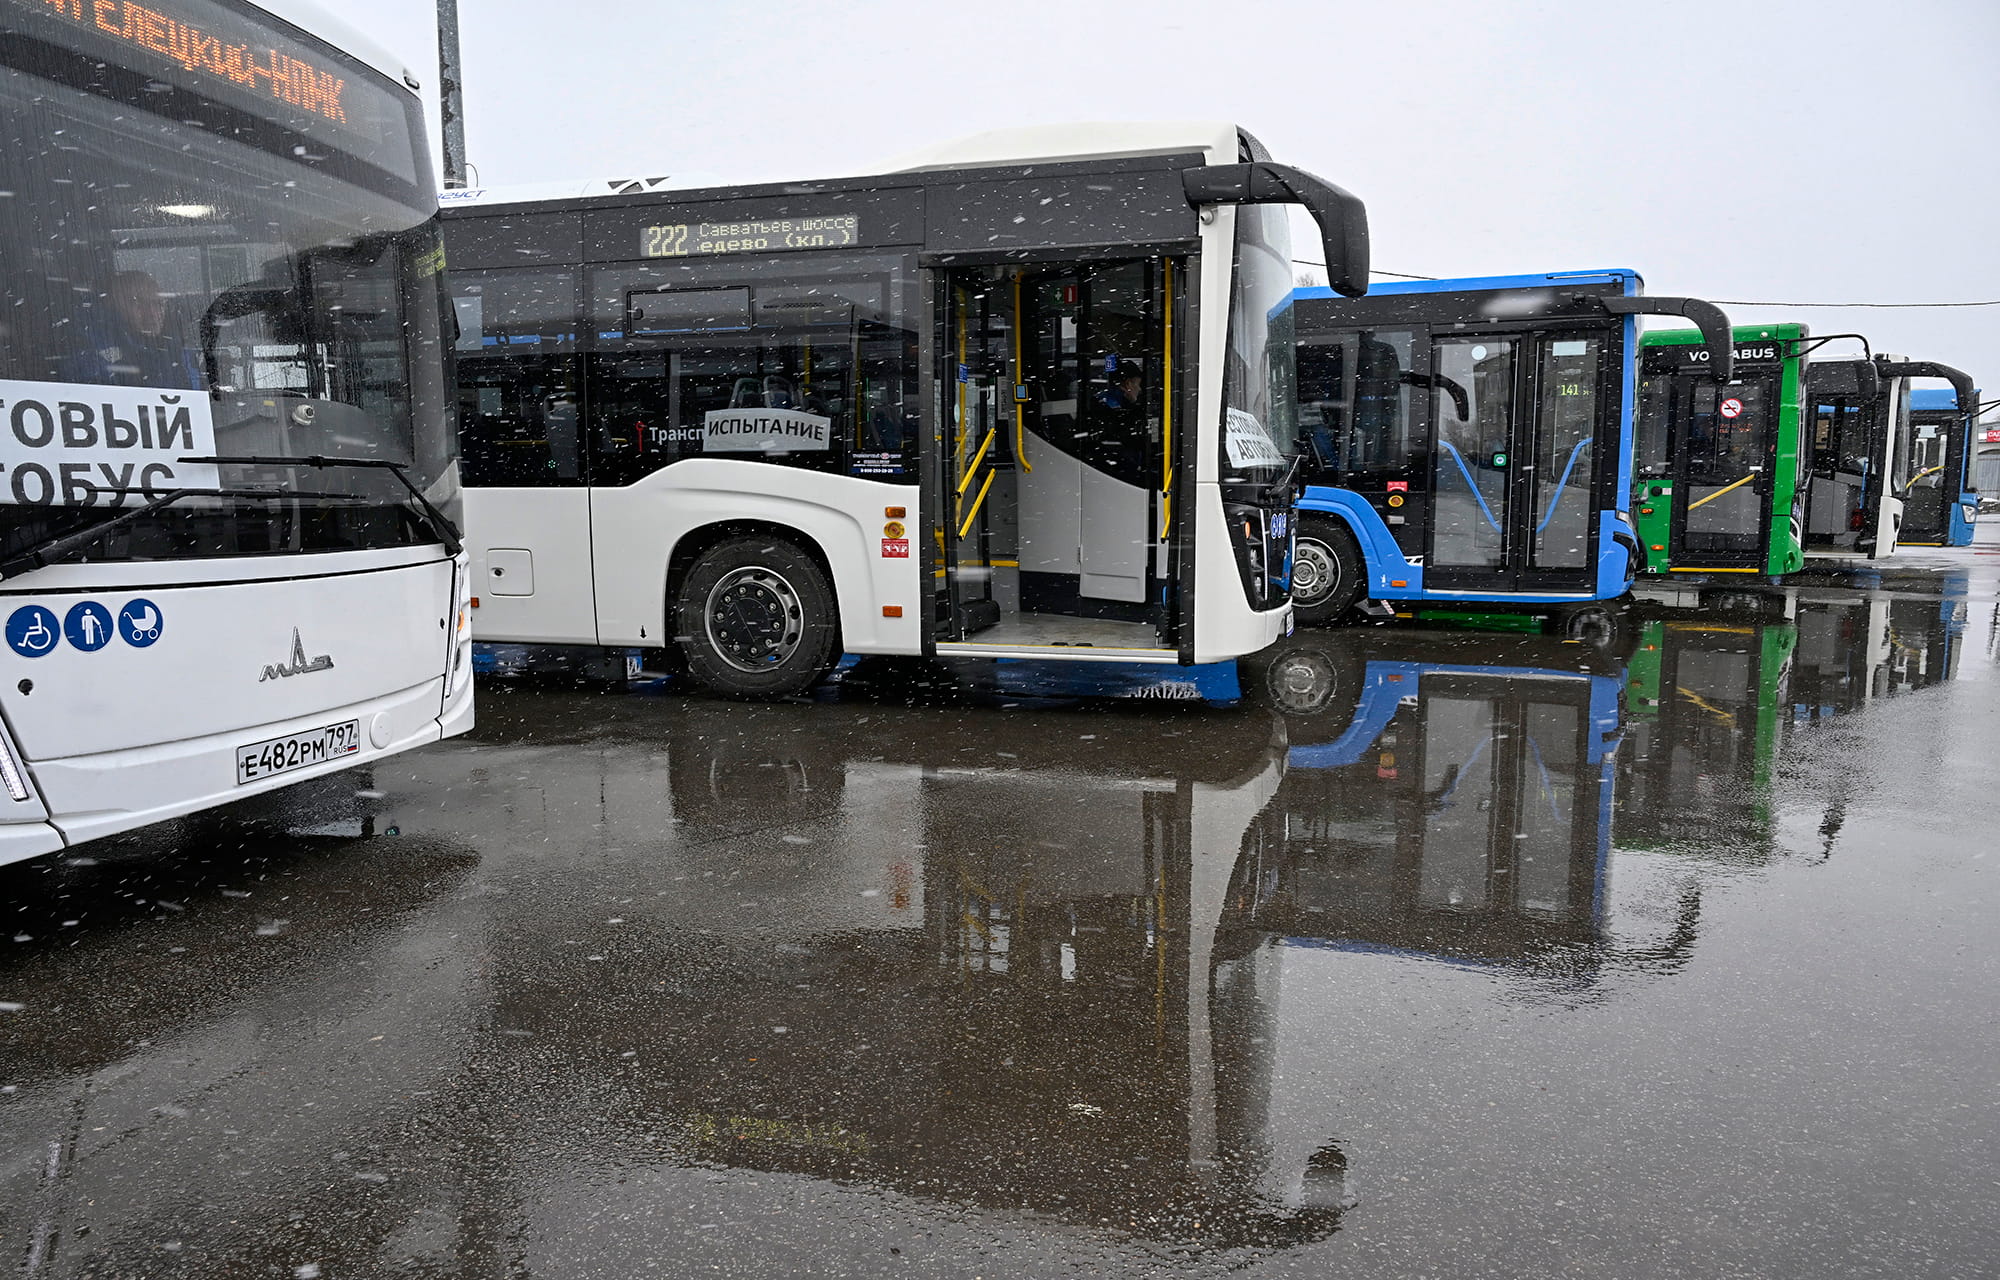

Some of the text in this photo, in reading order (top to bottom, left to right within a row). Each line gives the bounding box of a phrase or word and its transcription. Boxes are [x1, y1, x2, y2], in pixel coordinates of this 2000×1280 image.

[647, 224, 688, 256] 222
[1688, 348, 1775, 361] VOABUS
[1560, 384, 1579, 396] 141
[0, 394, 194, 450] ОВЫЙ
[709, 418, 824, 441] ИСПЫТАНИЕ
[0, 462, 175, 508] ОБУС
[327, 723, 354, 750] 797
[333, 744, 348, 755] RUS
